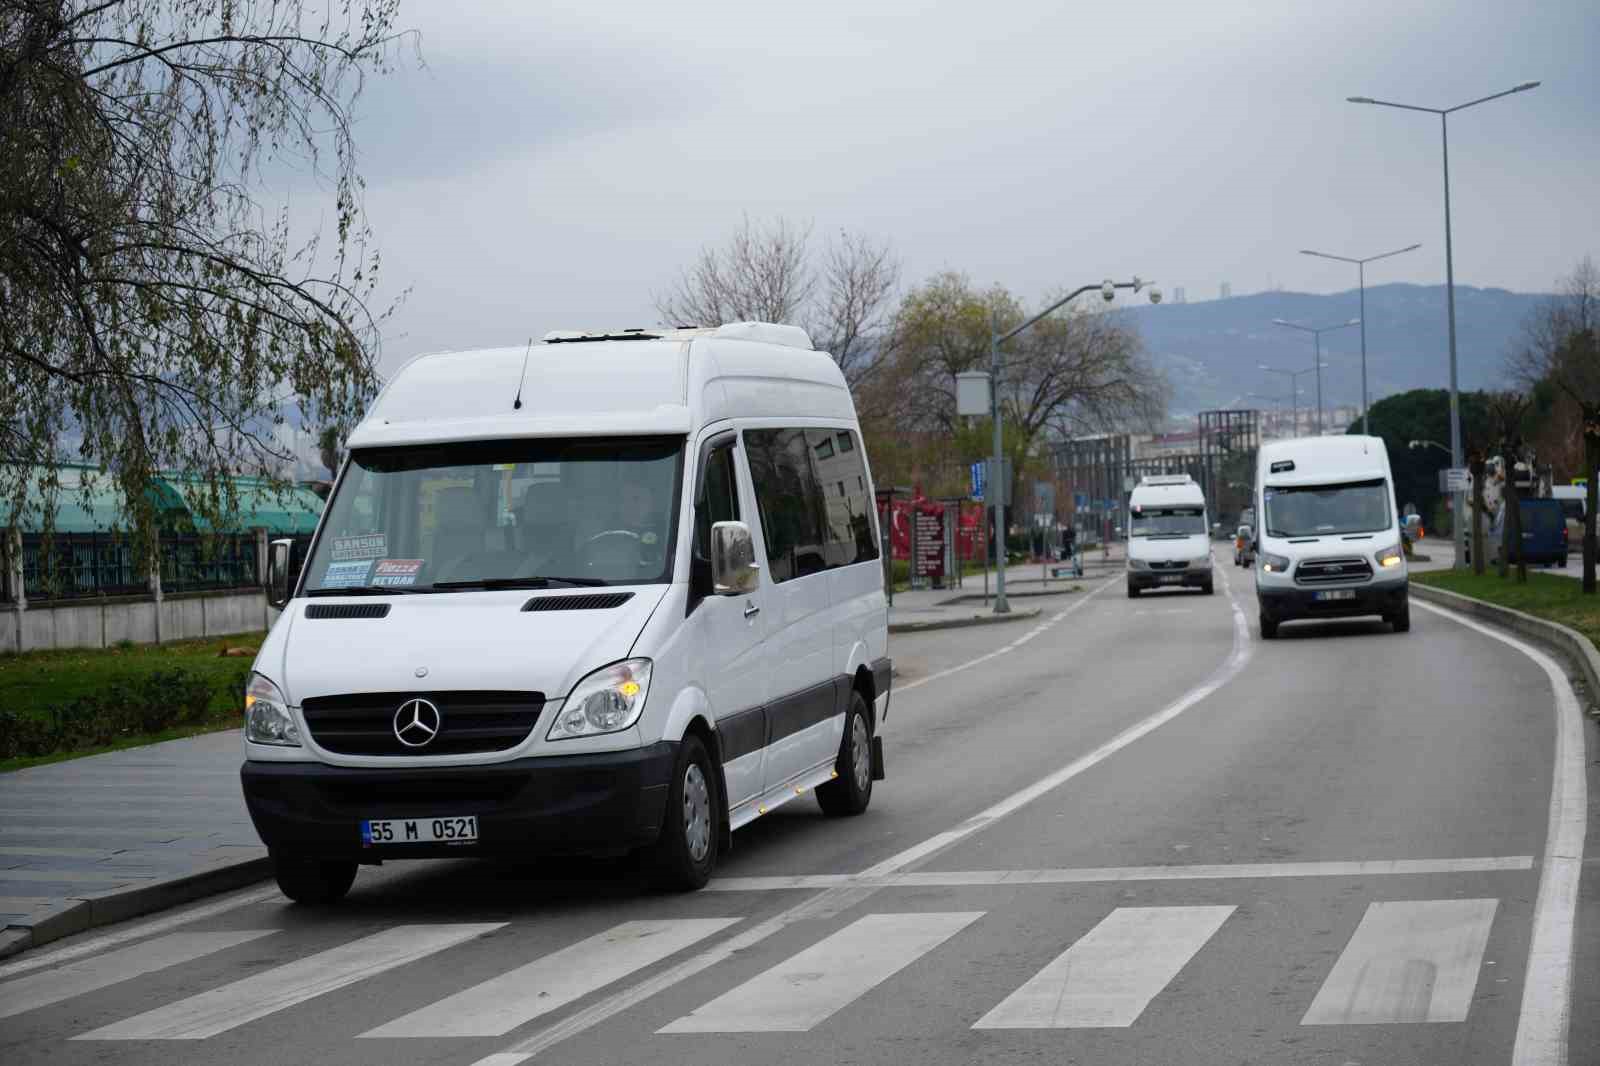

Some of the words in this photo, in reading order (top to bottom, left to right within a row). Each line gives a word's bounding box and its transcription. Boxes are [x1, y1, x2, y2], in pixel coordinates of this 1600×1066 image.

[371, 822, 393, 840] 55
[405, 821, 418, 840] M
[432, 818, 476, 838] 0521
